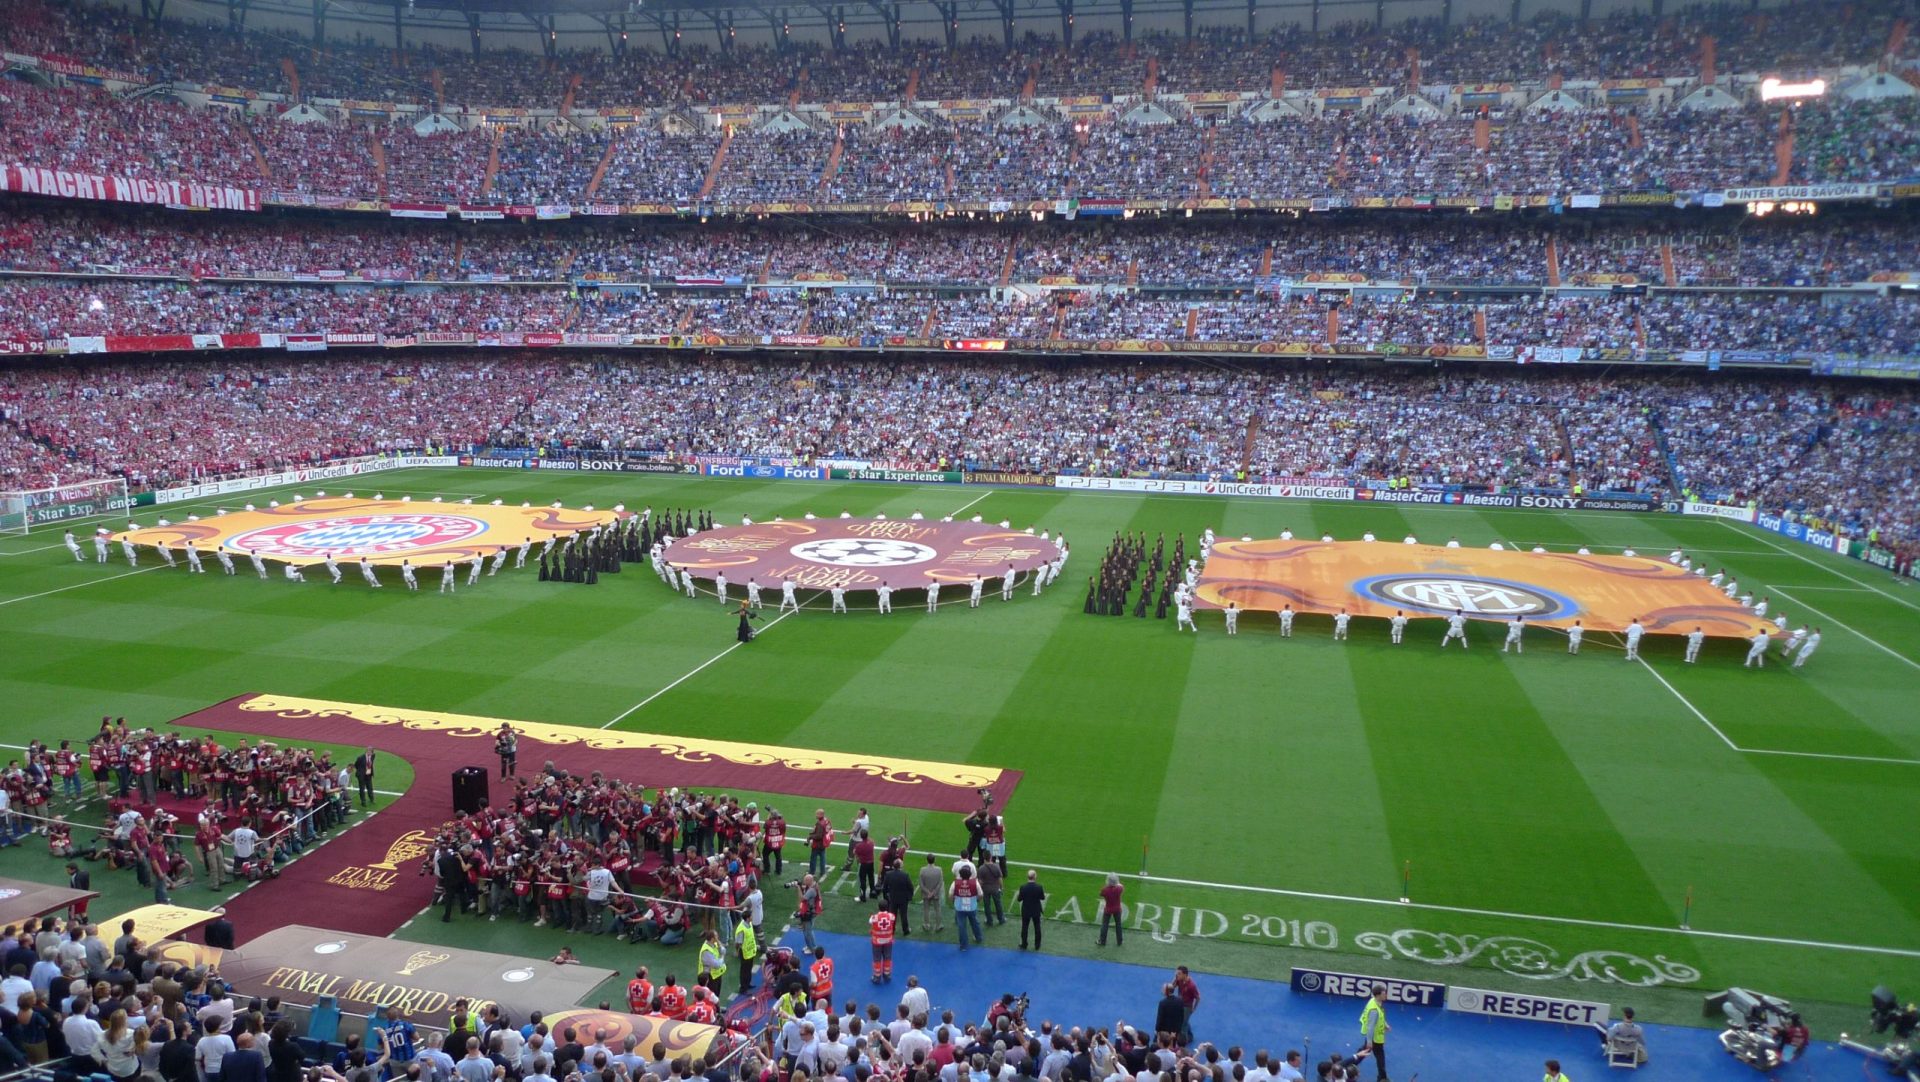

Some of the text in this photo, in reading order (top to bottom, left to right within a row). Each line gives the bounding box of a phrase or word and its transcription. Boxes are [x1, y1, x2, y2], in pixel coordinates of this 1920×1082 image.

[20, 167, 106, 200] NACHT
[113, 175, 182, 205] NICHT
[1739, 188, 1774, 200] INTER
[1777, 187, 1808, 199] CLUB
[327, 334, 376, 343] DONAUSTAUF
[361, 459, 396, 474] UniCredit
[473, 457, 523, 468] MasterCard
[539, 459, 575, 470] Maestro
[581, 460, 625, 471] SONY
[694, 456, 738, 466] ARNSBERG
[308, 465, 347, 480] UniCredit
[684, 464, 697, 474] 3D
[710, 465, 744, 476] Ford
[784, 466, 819, 479] Ford
[859, 470, 945, 482] Star Experience
[975, 474, 998, 483] FINAL
[1000, 474, 1030, 485] MADRID
[1218, 483, 1272, 496] UniCredit
[1294, 486, 1350, 499] UniCredit
[1374, 490, 1442, 504] MasterCard
[1463, 493, 1512, 507] Maestro
[1520, 496, 1581, 509] SONY
[38, 496, 138, 521] Star Expience
[1660, 501, 1679, 513] 3D
[1757, 513, 1781, 532] Ford
[1805, 529, 1834, 548] Ford
[1868, 549, 1889, 567] Star
[333, 866, 400, 885] FINAL
[1241, 913, 1339, 949] 2010
[262, 966, 343, 997] FINAL
[340, 978, 449, 1017] MADRID
[1324, 975, 1435, 1005] RESECT
[1482, 994, 1597, 1023] RESPECT
[388, 1032, 405, 1048] 10
